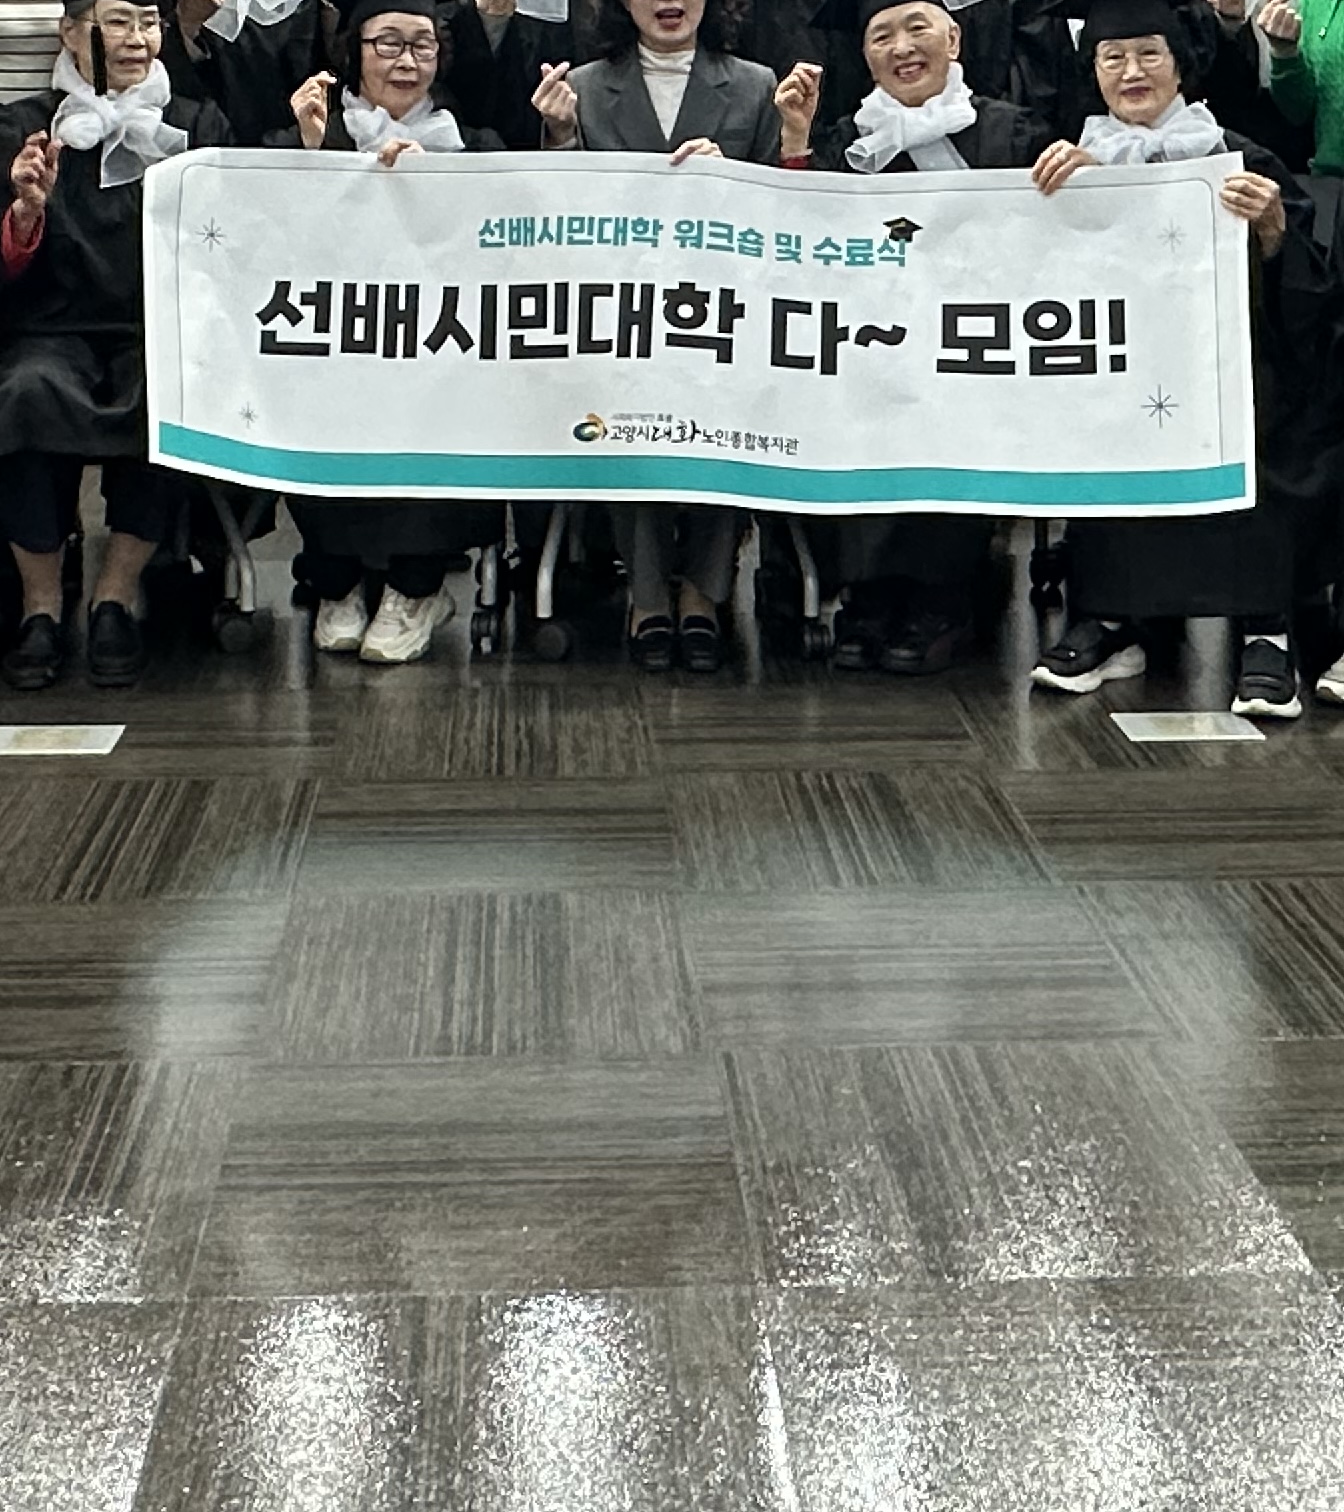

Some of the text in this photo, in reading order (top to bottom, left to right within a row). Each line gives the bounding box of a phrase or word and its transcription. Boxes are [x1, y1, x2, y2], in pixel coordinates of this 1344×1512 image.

[478, 215, 907, 268] 선배시민대학 워크숍 및 수료식
[254, 280, 1127, 376] 선배시민대학 다~ 모임!
